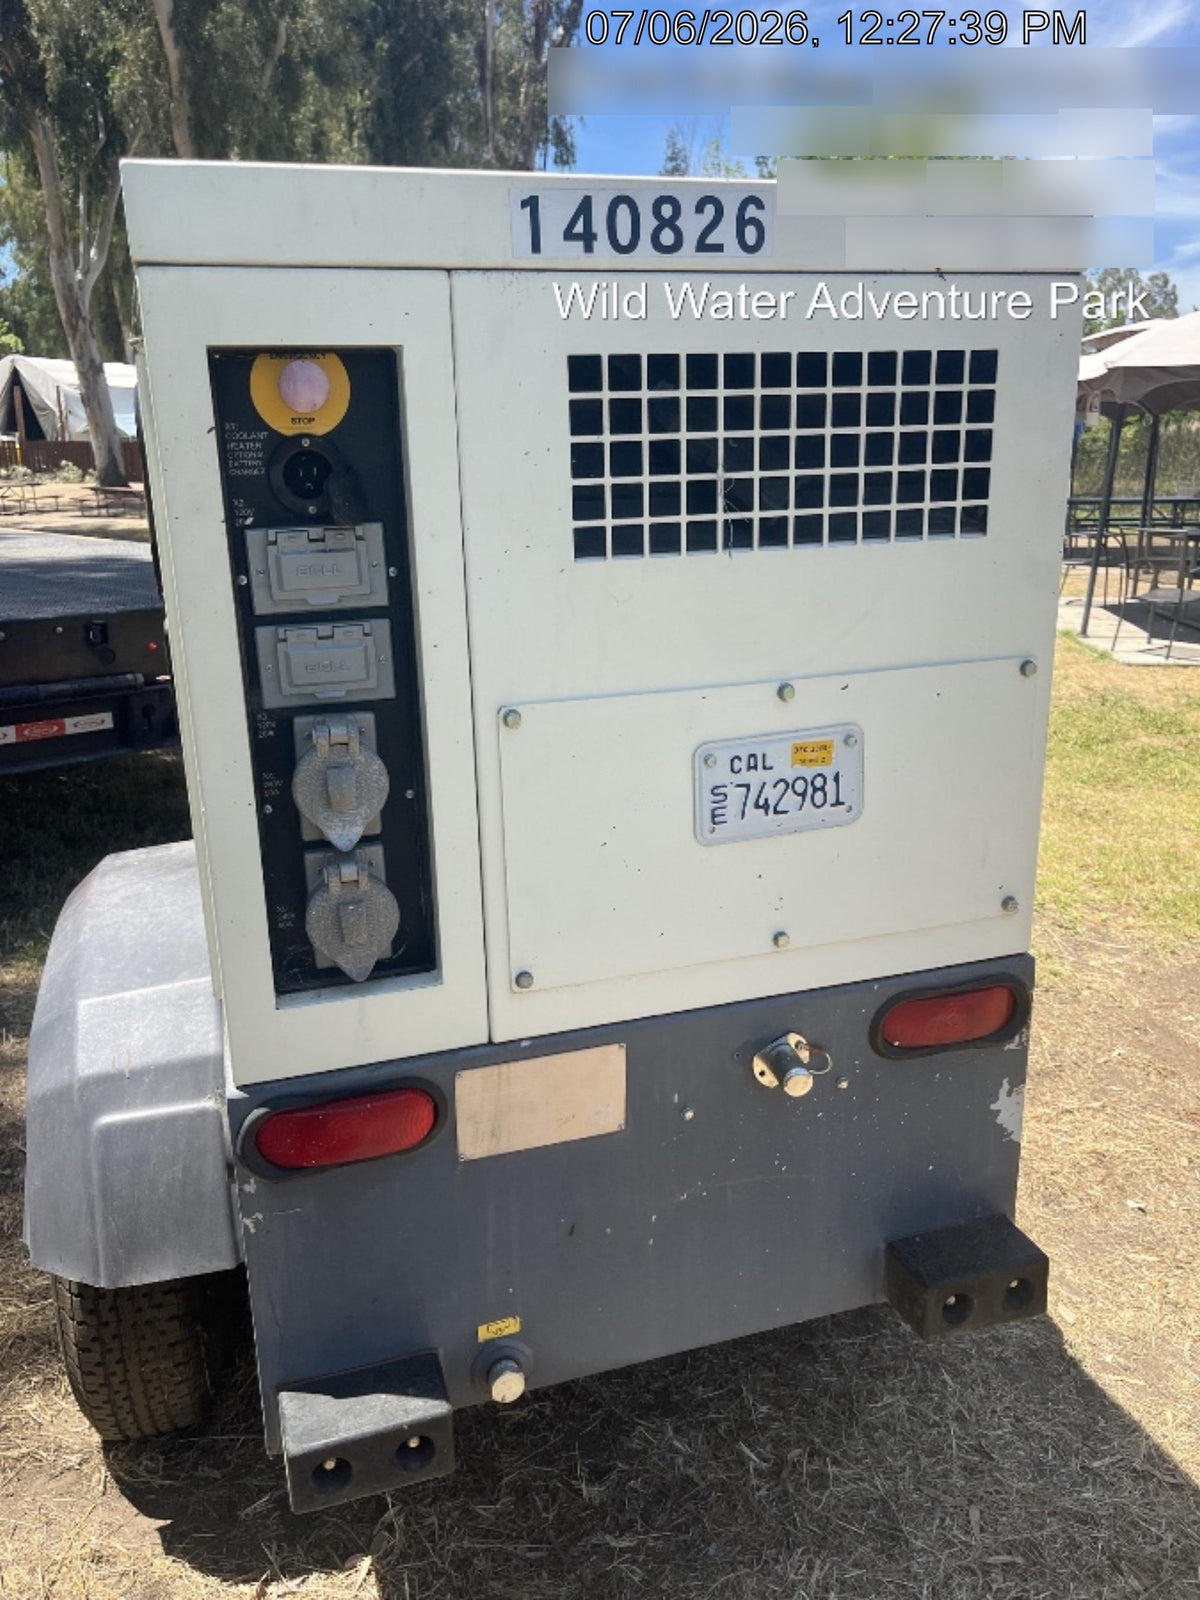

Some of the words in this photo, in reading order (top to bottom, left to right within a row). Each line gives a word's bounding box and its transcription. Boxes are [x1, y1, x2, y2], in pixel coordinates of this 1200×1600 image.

[520, 194, 766, 254] 140826
[291, 417, 315, 425] STOP
[225, 431, 268, 440] COOLANT
[227, 441, 262, 450] HEATER
[730, 753, 774, 774] CAL
[710, 784, 728, 826] SE
[734, 771, 845, 820] 742981
